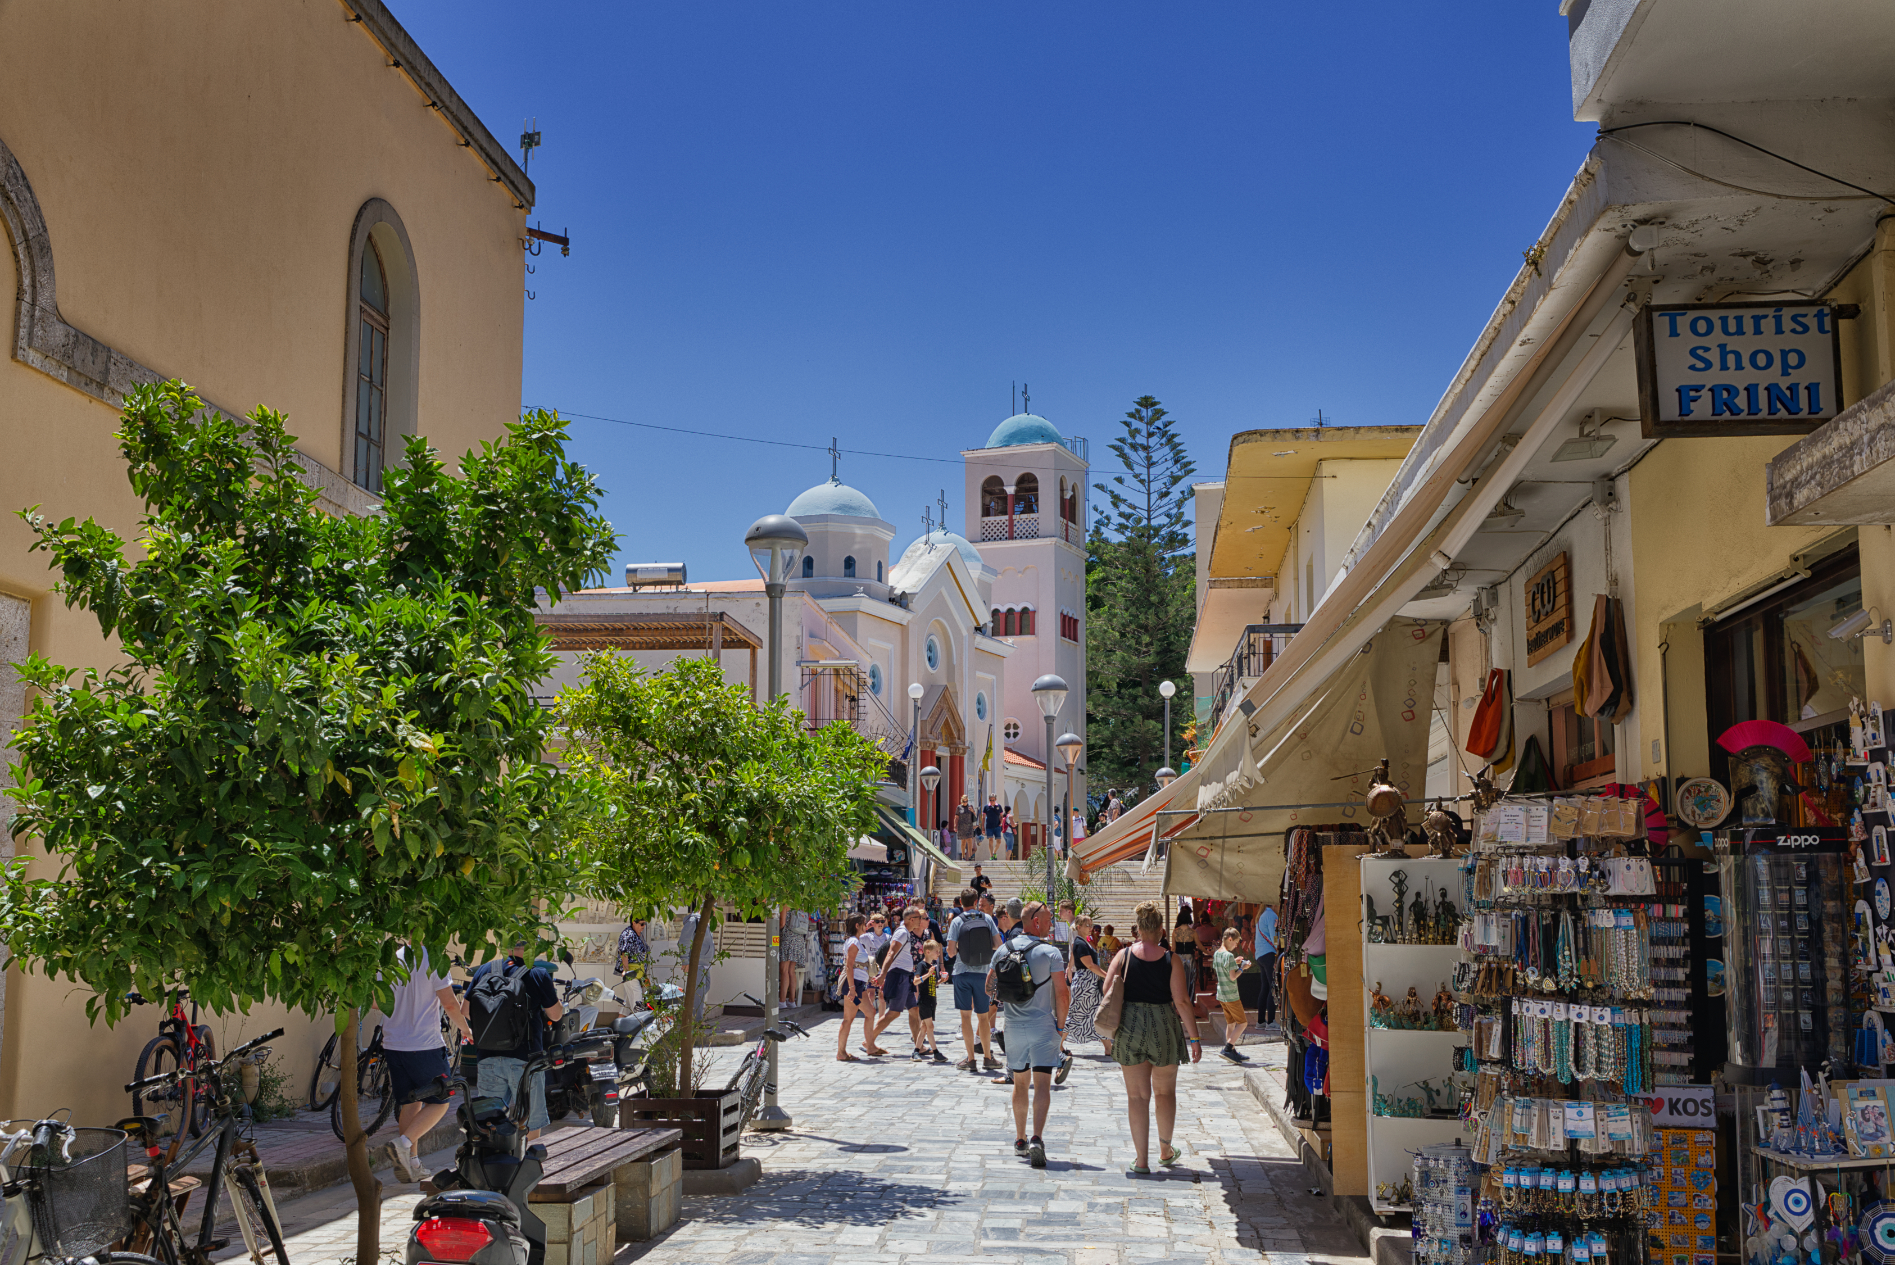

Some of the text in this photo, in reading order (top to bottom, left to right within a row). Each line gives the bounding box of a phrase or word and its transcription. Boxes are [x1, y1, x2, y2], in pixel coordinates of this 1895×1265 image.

[1658, 307, 1831, 338] Tourist
[1687, 343, 1806, 377] Shop
[1675, 382, 1824, 417] FRINI
[1776, 833, 1820, 849] zippo
[1668, 1097, 1713, 1117] KOS
